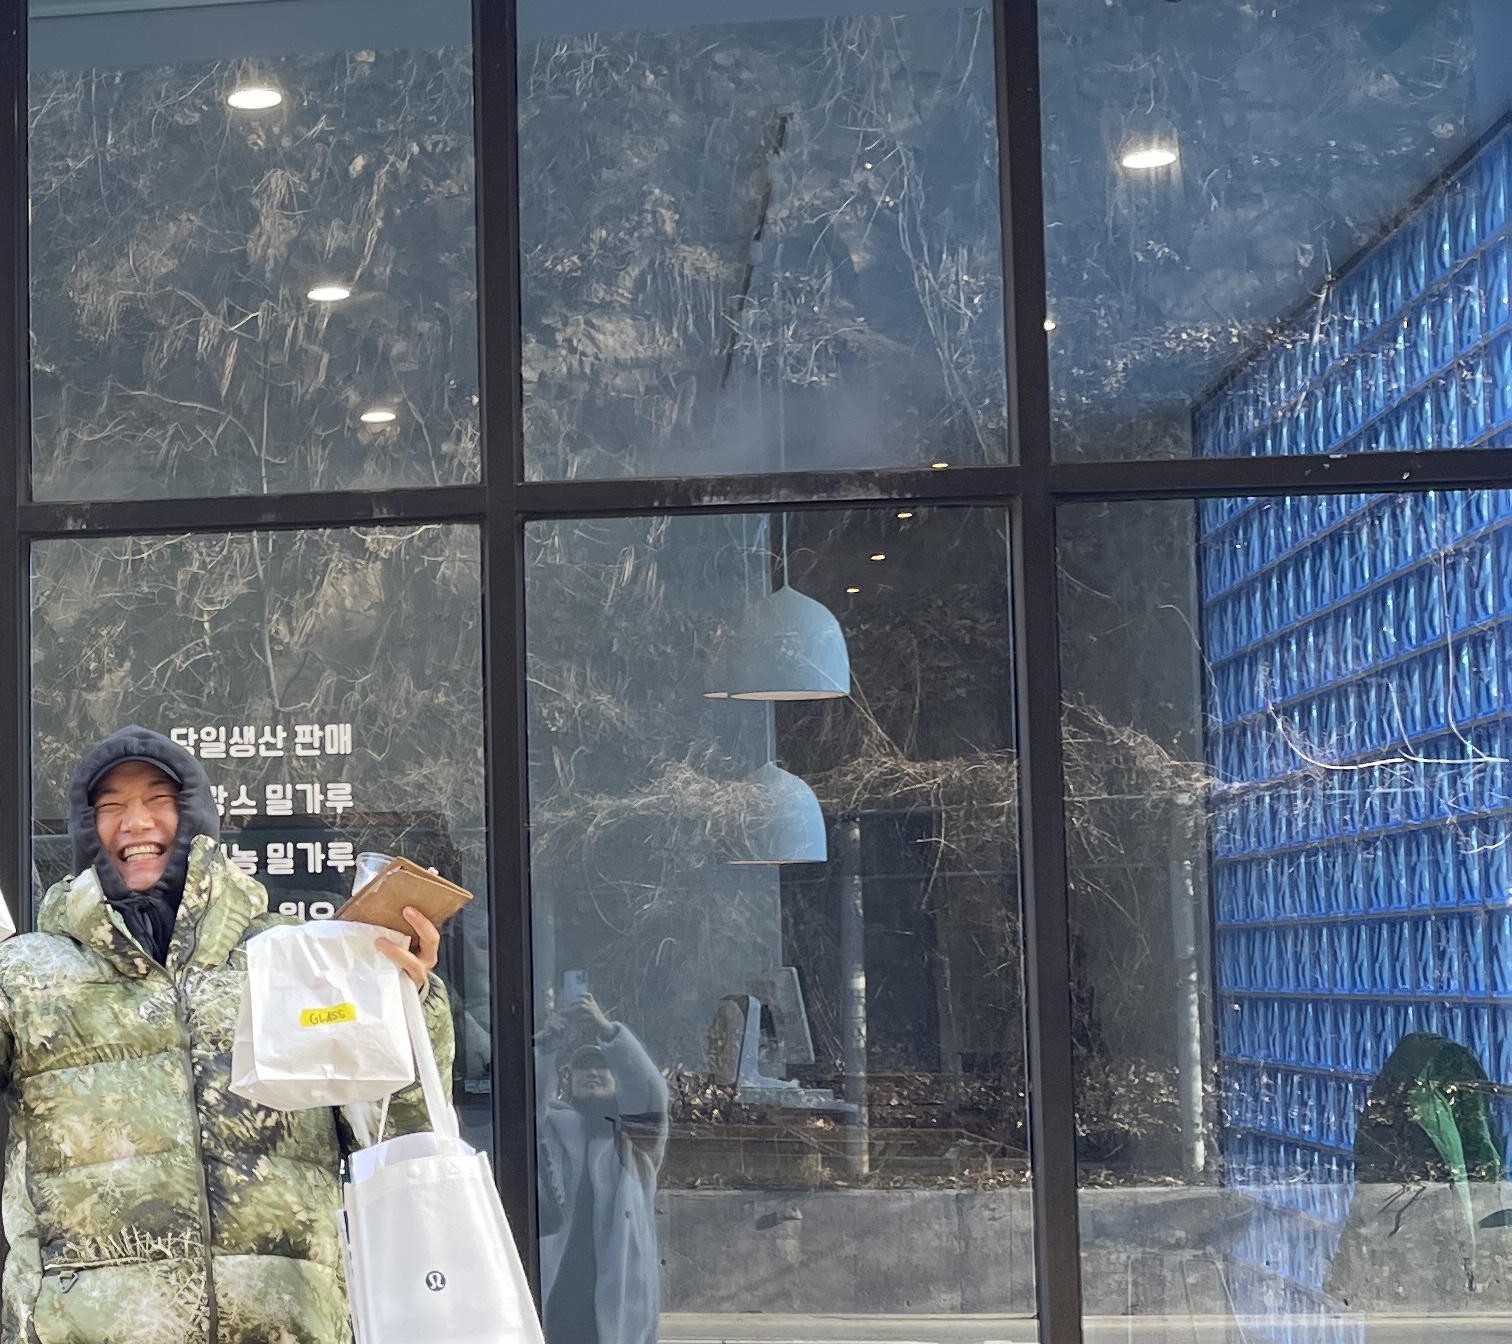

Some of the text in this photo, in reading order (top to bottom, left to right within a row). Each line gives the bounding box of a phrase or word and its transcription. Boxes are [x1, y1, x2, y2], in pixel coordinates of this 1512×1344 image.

[294, 723, 352, 756] 판매
[265, 782, 354, 816] 밀가루
[266, 842, 355, 875] 밀가루
[309, 1008, 346, 1025] GLASS
